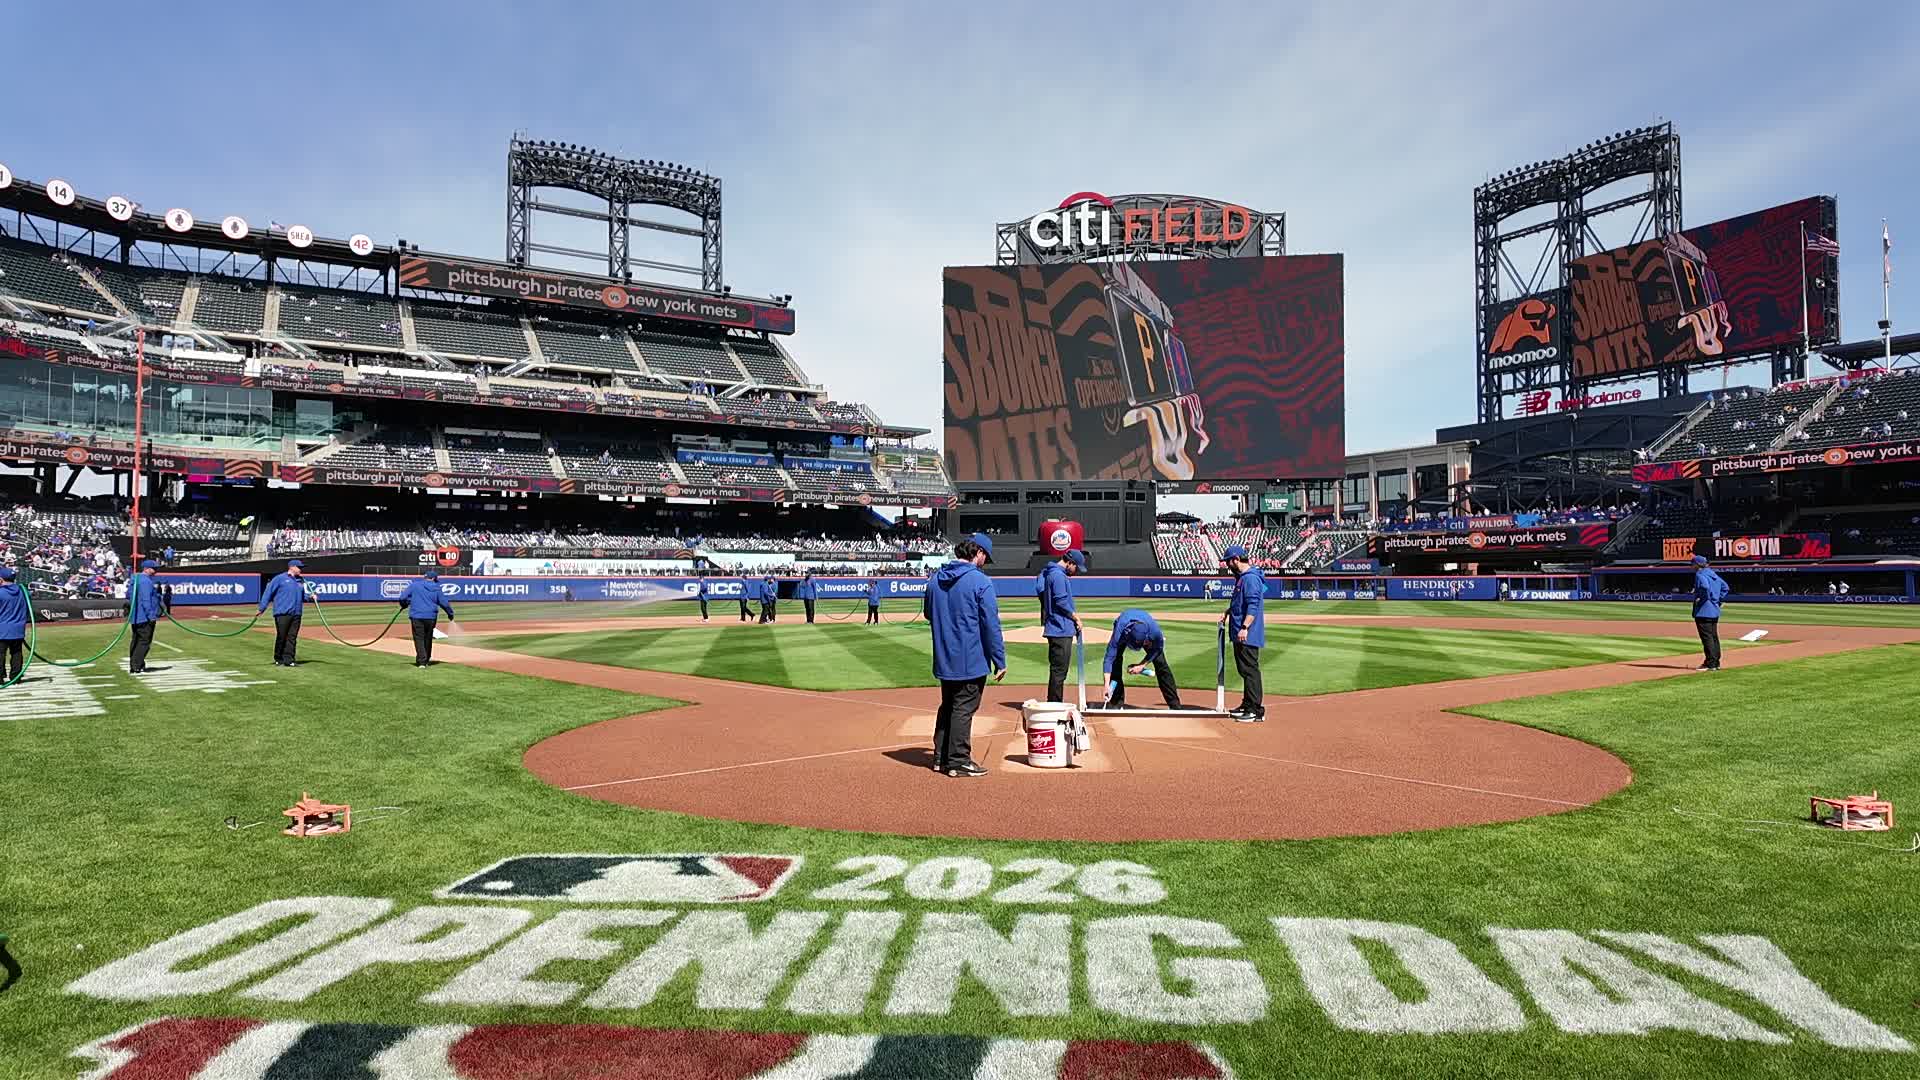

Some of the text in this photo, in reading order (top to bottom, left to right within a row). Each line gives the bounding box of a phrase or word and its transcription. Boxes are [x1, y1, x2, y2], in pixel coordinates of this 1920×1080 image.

[54, 186, 67, 199] 14
[111, 202, 127, 215] 37
[1029, 201, 1250, 248] citi FIELD
[291, 231, 310, 241] SHEA
[354, 240, 369, 250] 42
[449, 269, 541, 297] pittsburgh
[546, 279, 602, 301] pirates
[627, 294, 658, 309] new
[662, 299, 697, 317] york
[700, 303, 737, 319] mets
[1489, 346, 1558, 370] moomoo
[68, 355, 209, 382] pittsburgh pirate new york mets
[262, 378, 303, 391] pittsburgh
[305, 381, 331, 392] pirates
[358, 385, 375, 395] york
[376, 387, 395, 396] mets
[443, 393, 479, 404] pittsburgh
[481, 396, 504, 406] pirates
[528, 399, 543, 408] york
[1584, 388, 1642, 408] balance
[20, 442, 68, 459] pirates
[86, 452, 112, 463] new
[116, 453, 141, 467] yor
[1712, 454, 1777, 474] pittsburgh
[1780, 450, 1825, 469] pirates
[1846, 449, 1876, 460] new
[1879, 443, 1913, 460] york
[326, 471, 519, 488] pittsburgh pirates new york mets
[584, 482, 741, 498] pittsburgh pirates new york mets
[1213, 484, 1250, 492] moomoo
[793, 492, 833, 505] pittsburgh
[834, 494, 859, 505] pirates
[886, 495, 902, 506] york
[903, 497, 921, 505] mets
[1449, 516, 1512, 529] citi PAVILION
[1385, 529, 1567, 551] pittsburgh pirates new york mets
[1715, 539, 1733, 557] PIT
[419, 553, 436, 562] citi
[445, 552, 457, 560] 00
[1341, 563, 1372, 571] $20,000
[160, 582, 233, 595] martwater
[303, 580, 358, 594] Canon
[465, 584, 529, 595] HYUNDAI
[549, 585, 566, 594] 358
[824, 584, 856, 592] Invesco
[1154, 583, 1191, 592] DELTA
[1403, 580, 1475, 590] HENDRICK'S
[1280, 591, 1294, 599] 380
[1531, 591, 1571, 600] DUNKIN'
[1580, 591, 1593, 600] 370
[1834, 595, 1909, 603] CADILLAC
[810, 853, 1169, 906] 2026
[63, 895, 1271, 1026] OPENING
[1271, 914, 1918, 1052] DAY
